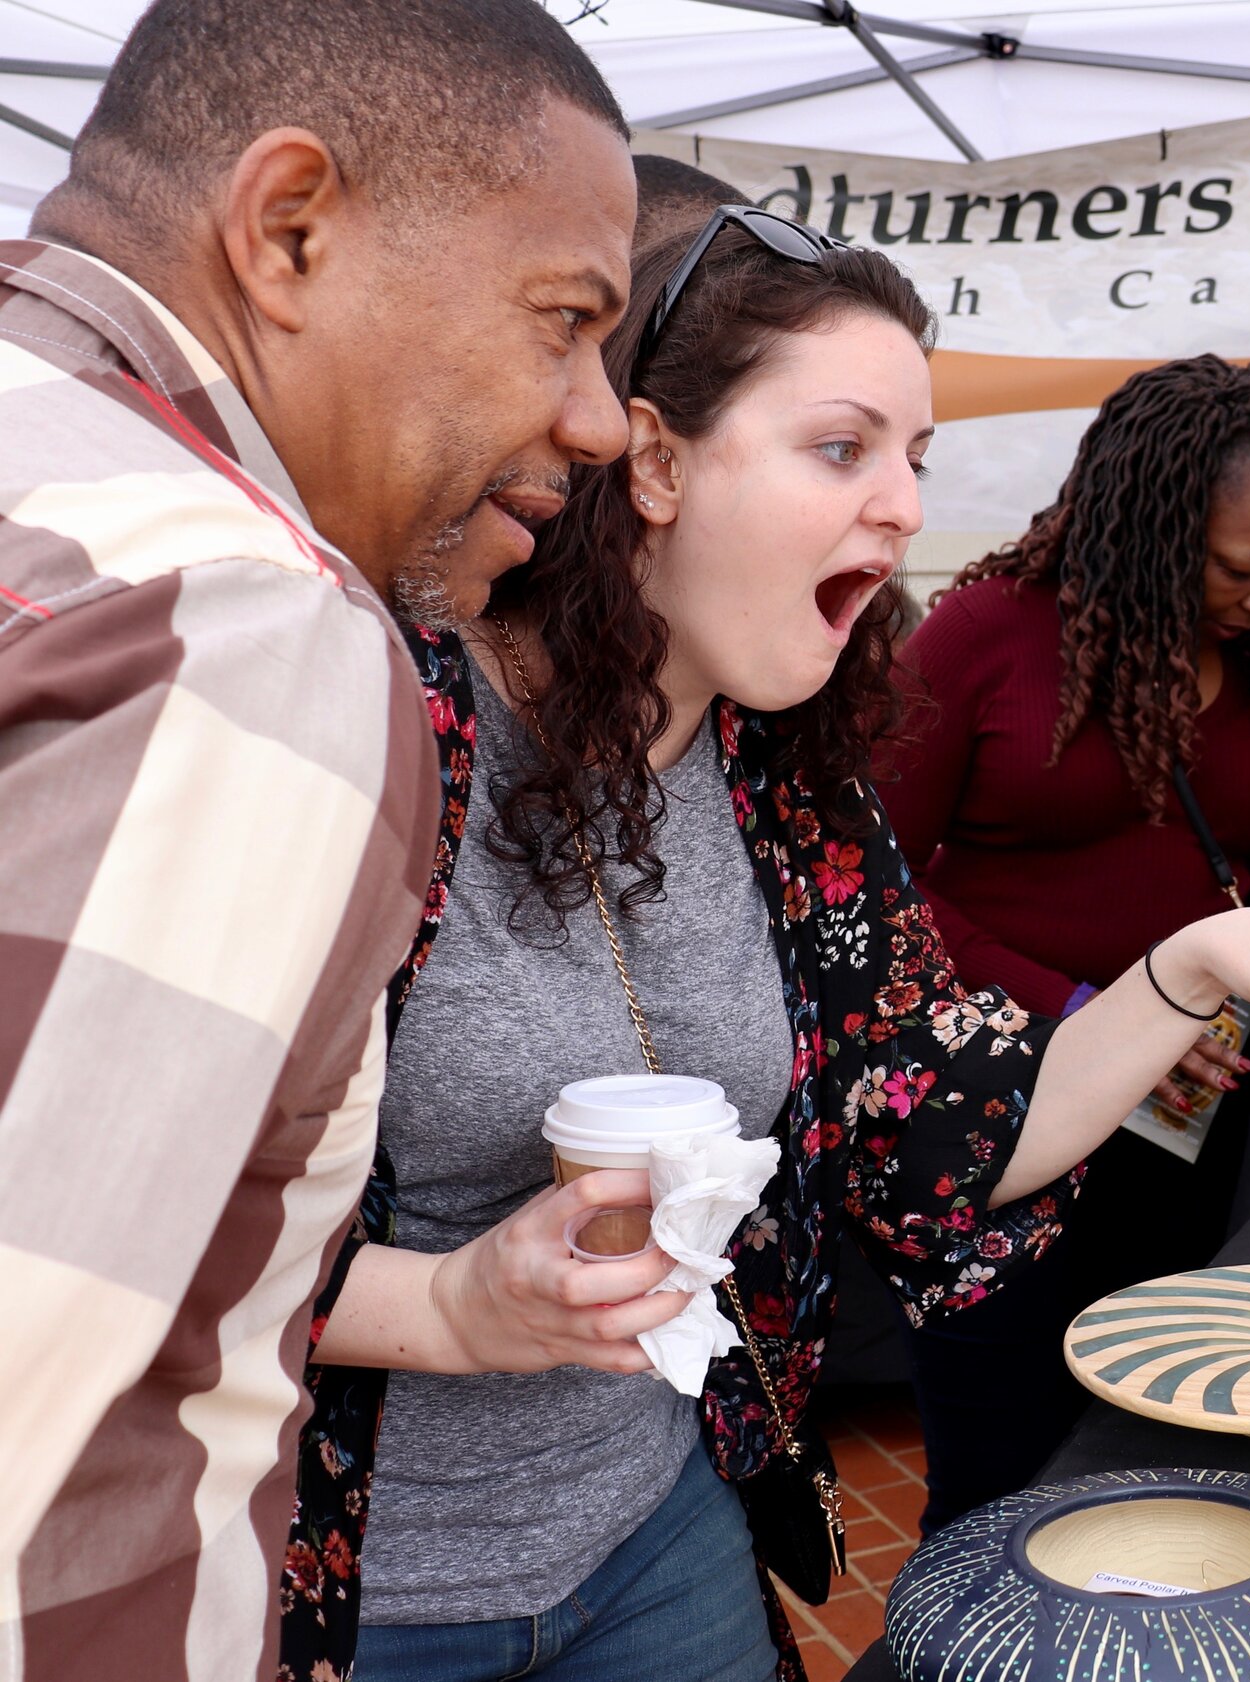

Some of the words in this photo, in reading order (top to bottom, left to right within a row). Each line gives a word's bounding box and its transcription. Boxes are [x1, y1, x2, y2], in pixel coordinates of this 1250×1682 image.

[756, 164, 1234, 245] dturners
[1095, 1572, 1138, 1586] Carved
[1139, 1581, 1179, 1594] Poplar
